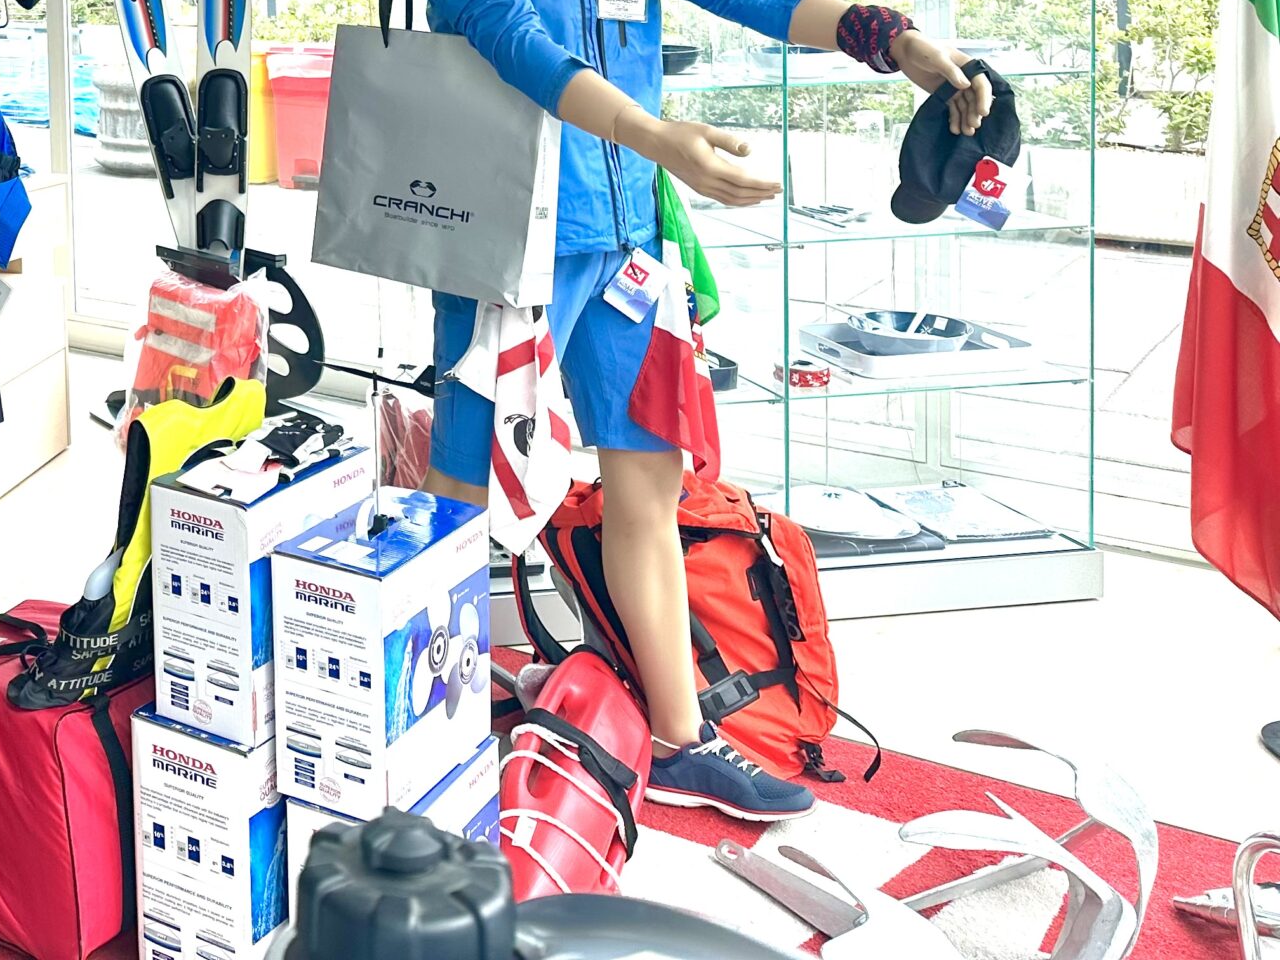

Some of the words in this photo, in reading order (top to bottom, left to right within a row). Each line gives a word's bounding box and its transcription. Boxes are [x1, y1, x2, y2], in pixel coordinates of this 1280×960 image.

[373, 194, 470, 223] CRANCHI
[333, 467, 365, 488] HONDA
[170, 508, 224, 530] HONDA
[171, 520, 224, 541] MARINE
[455, 530, 483, 553] HONDA
[295, 579, 356, 602] HONDA
[296, 591, 356, 614] MARINE
[48, 670, 112, 691] ATTITUDE
[152, 744, 217, 775] HONDA
[153, 758, 217, 789] MARINE
